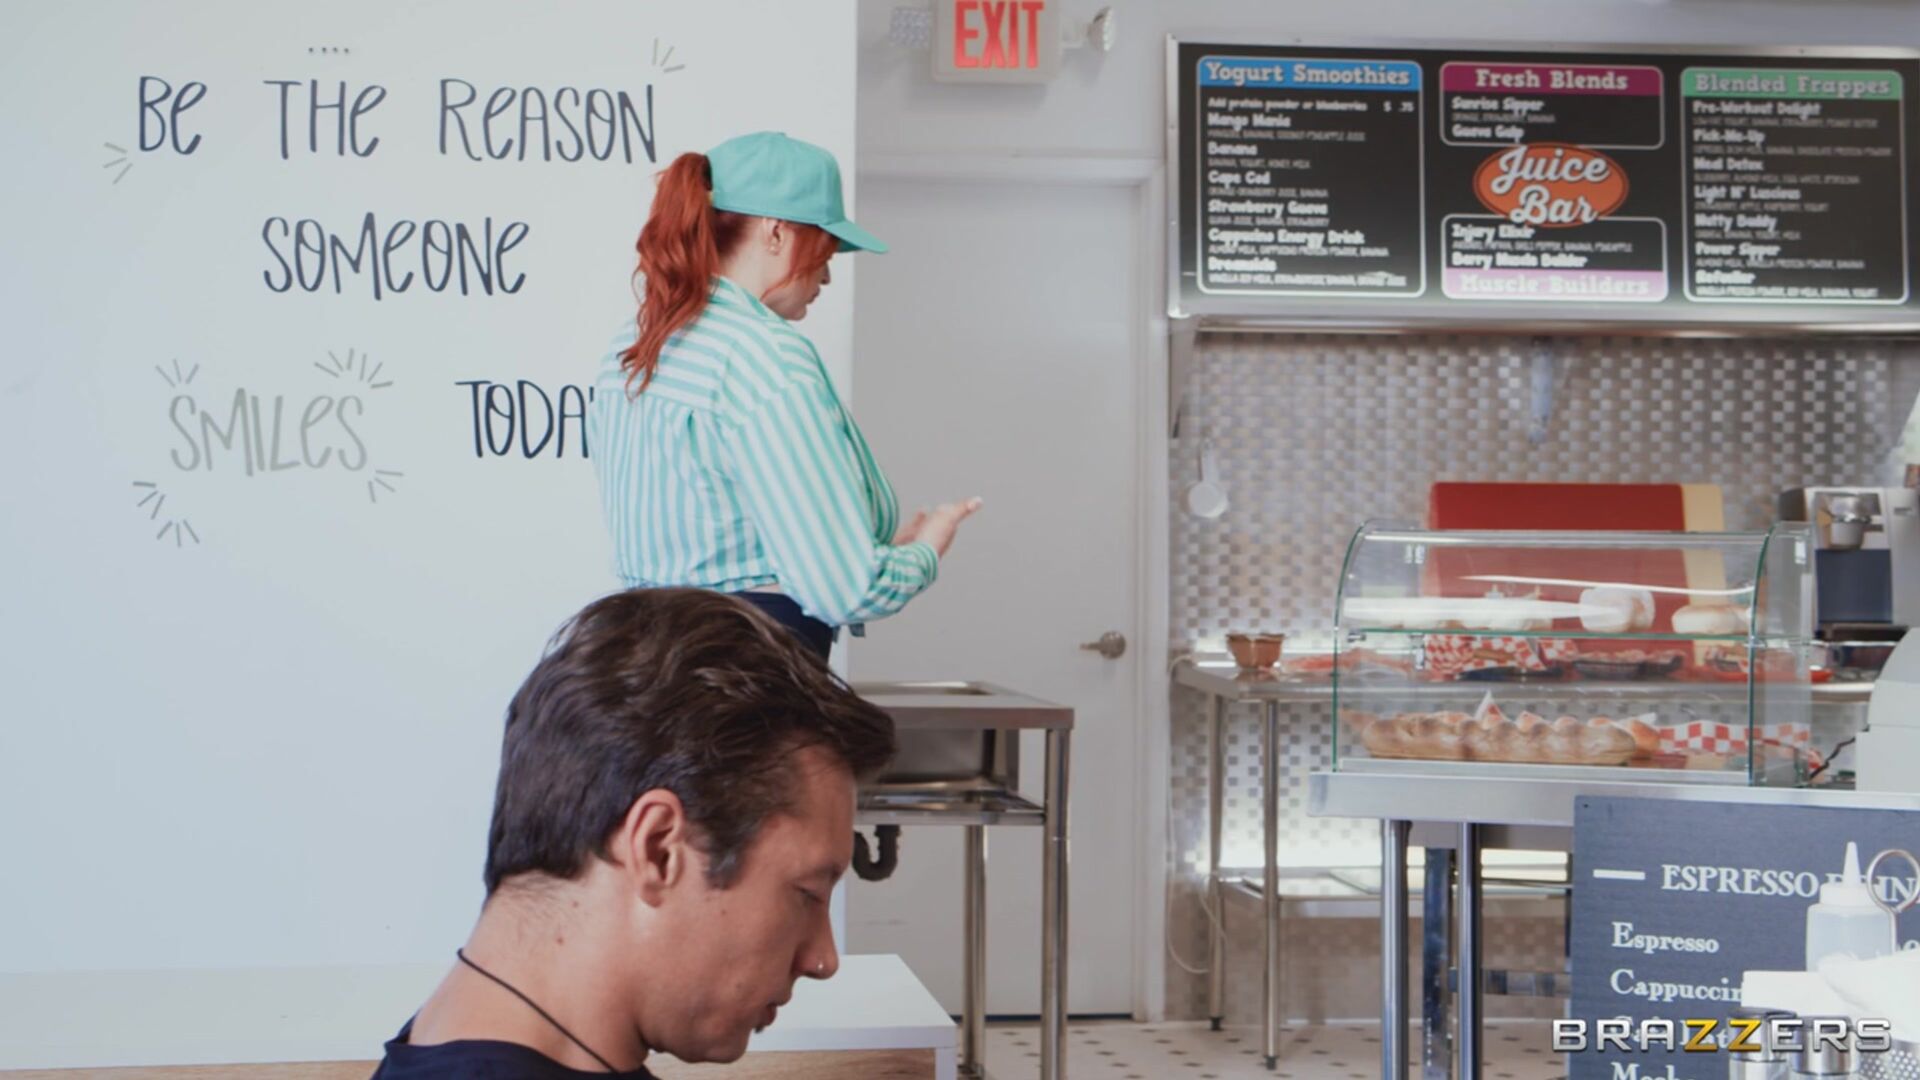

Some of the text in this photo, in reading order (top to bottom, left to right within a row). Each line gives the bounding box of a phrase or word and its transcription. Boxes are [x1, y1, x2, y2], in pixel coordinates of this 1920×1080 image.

[954, 0, 1044, 69] EXIT
[1205, 62, 1410, 86] Yogurt Smoothies
[1475, 69, 1628, 90] Fresh Blends
[1695, 75, 1889, 98] Blended Frappes
[1208, 113, 1248, 131] Mango
[1208, 141, 1257, 155] Banana
[1491, 145, 1610, 194] Juice
[1510, 185, 1598, 224] Bar
[1694, 186, 1726, 204] Light
[1208, 199, 1284, 218] Strawberry
[1459, 274, 1649, 294] Muscle Builders
[454, 379, 595, 459] TODA
[1662, 865, 1819, 897] ESPRESSO
[1612, 922, 1719, 953] Espresso
[1610, 969, 1743, 1002] Cappuccin
